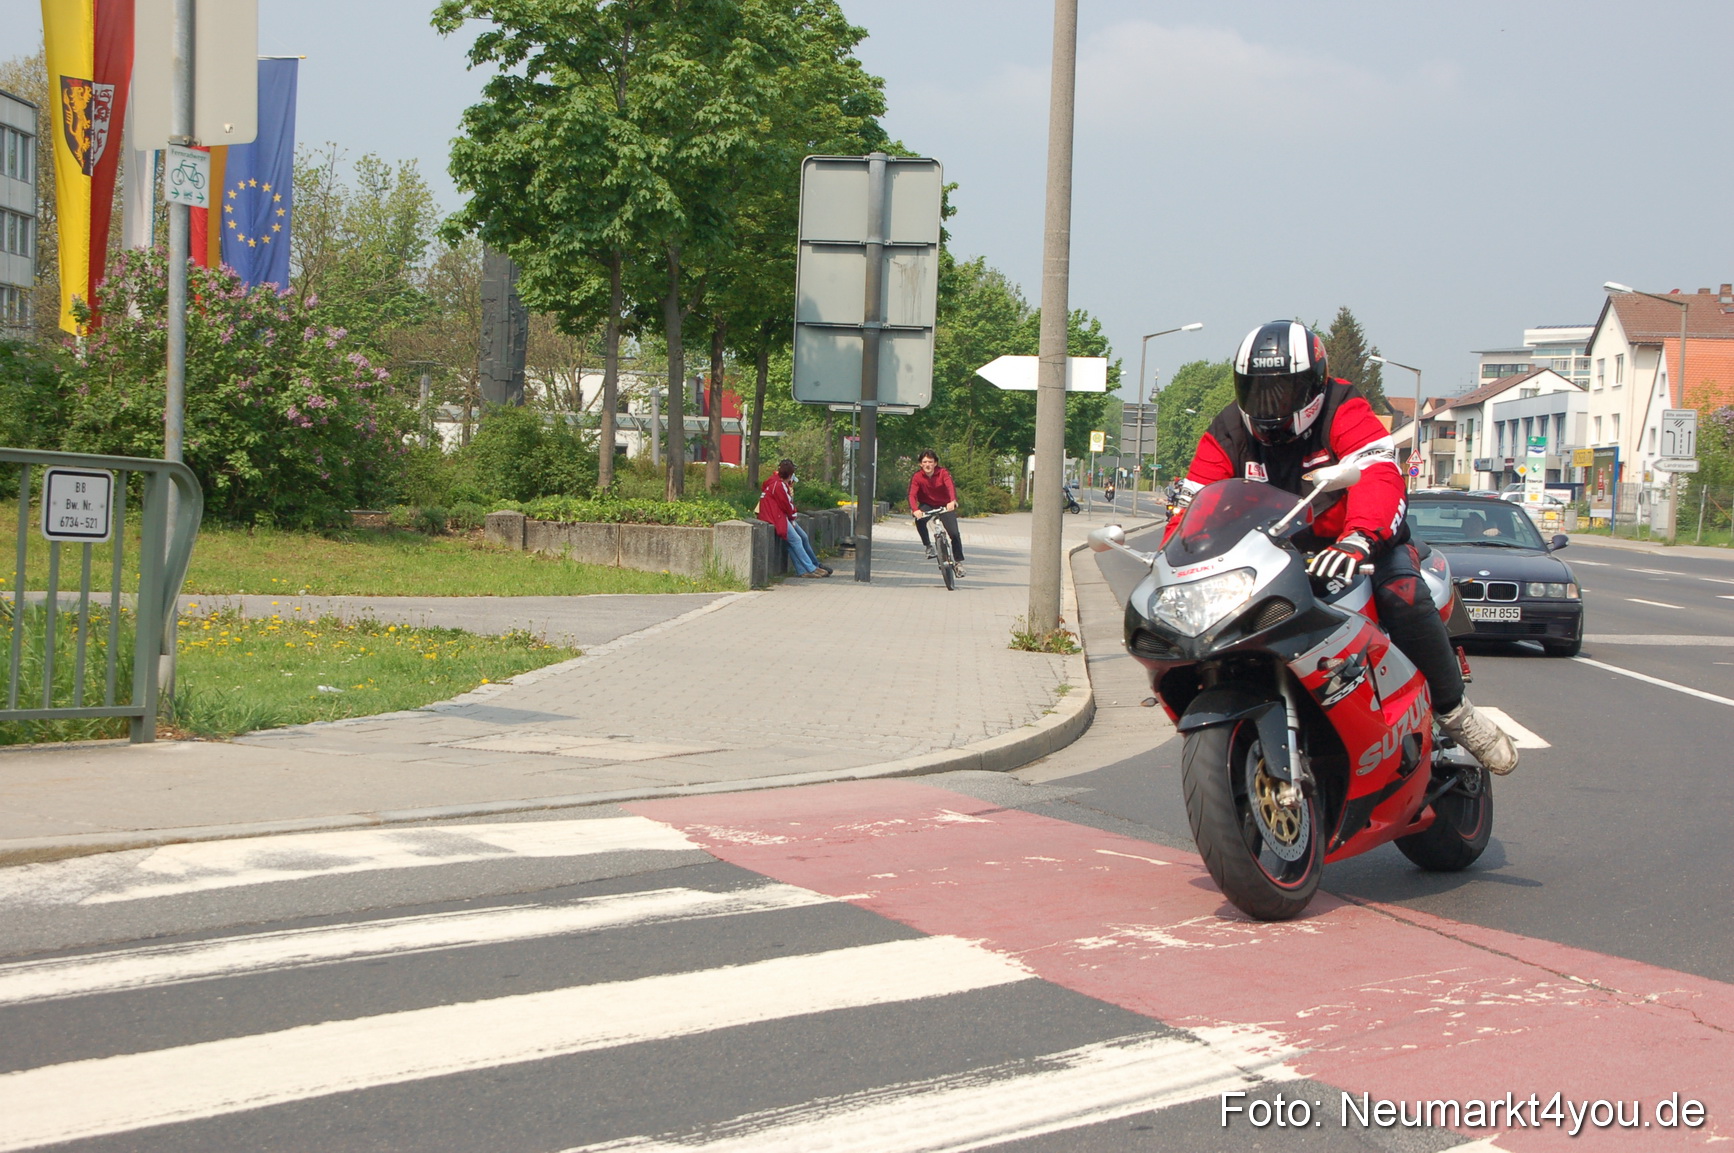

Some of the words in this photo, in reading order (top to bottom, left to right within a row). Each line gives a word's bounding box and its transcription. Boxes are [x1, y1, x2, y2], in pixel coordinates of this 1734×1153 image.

[1252, 356, 1285, 368] SHOEI
[66, 498, 79, 511] Bw.
[82, 500, 94, 512] Nr.
[60, 516, 98, 529] 6734-521
[1177, 565, 1214, 578] SUZUKI
[1481, 608, 1497, 618] RH
[1499, 608, 1519, 619] 855
